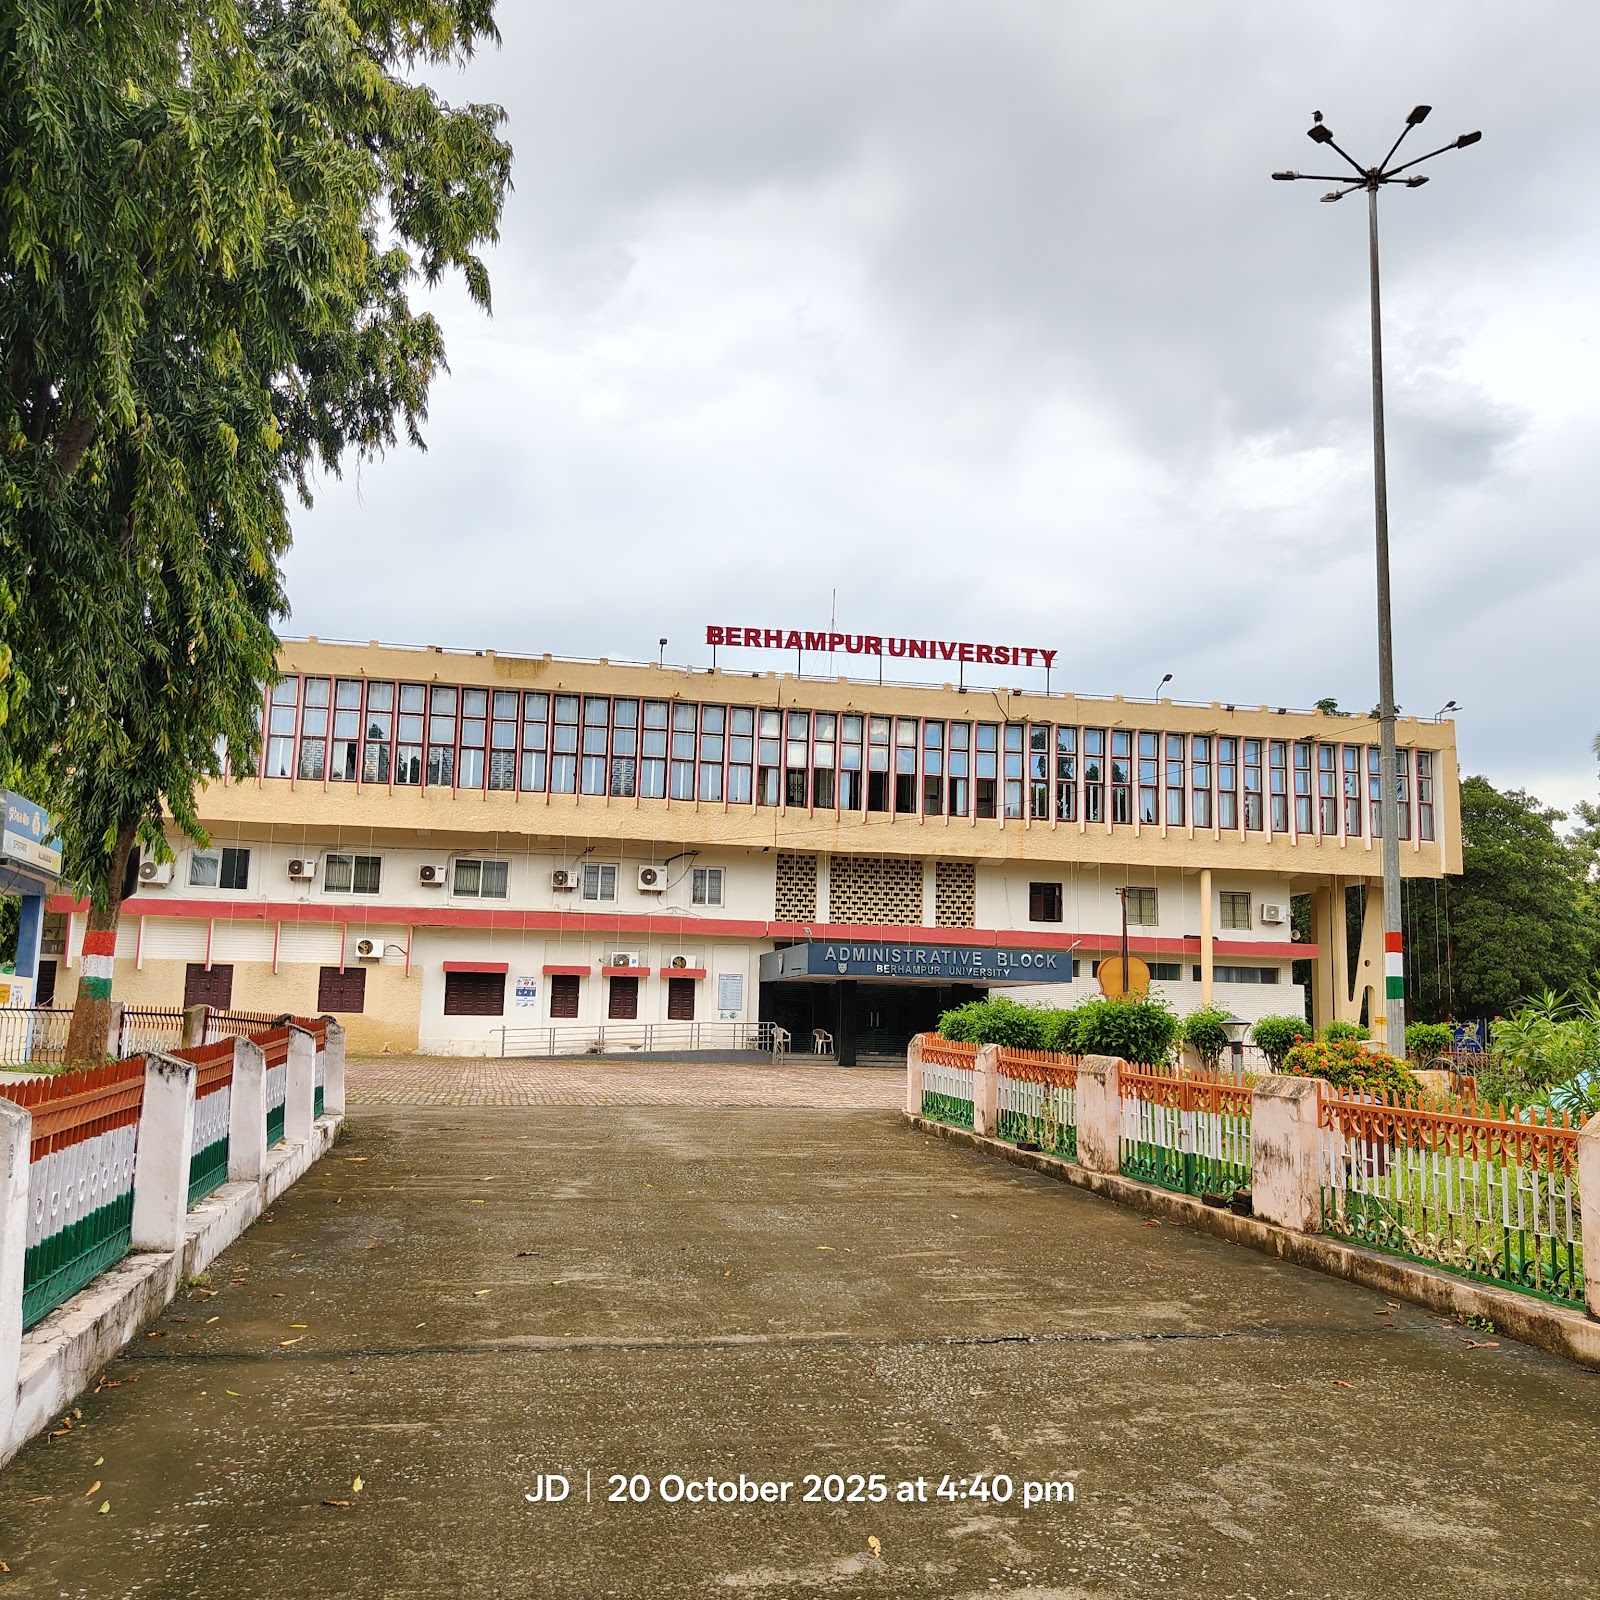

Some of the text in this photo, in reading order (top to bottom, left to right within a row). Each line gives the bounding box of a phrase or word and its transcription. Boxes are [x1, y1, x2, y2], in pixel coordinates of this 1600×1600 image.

[706, 625, 1058, 668] BERHAMPUR UNIVERSITY
[824, 946, 1058, 969] ADMINISTRATIVE BLOCK
[876, 964, 1010, 978] BERHAMPUR UNIVERSITY
